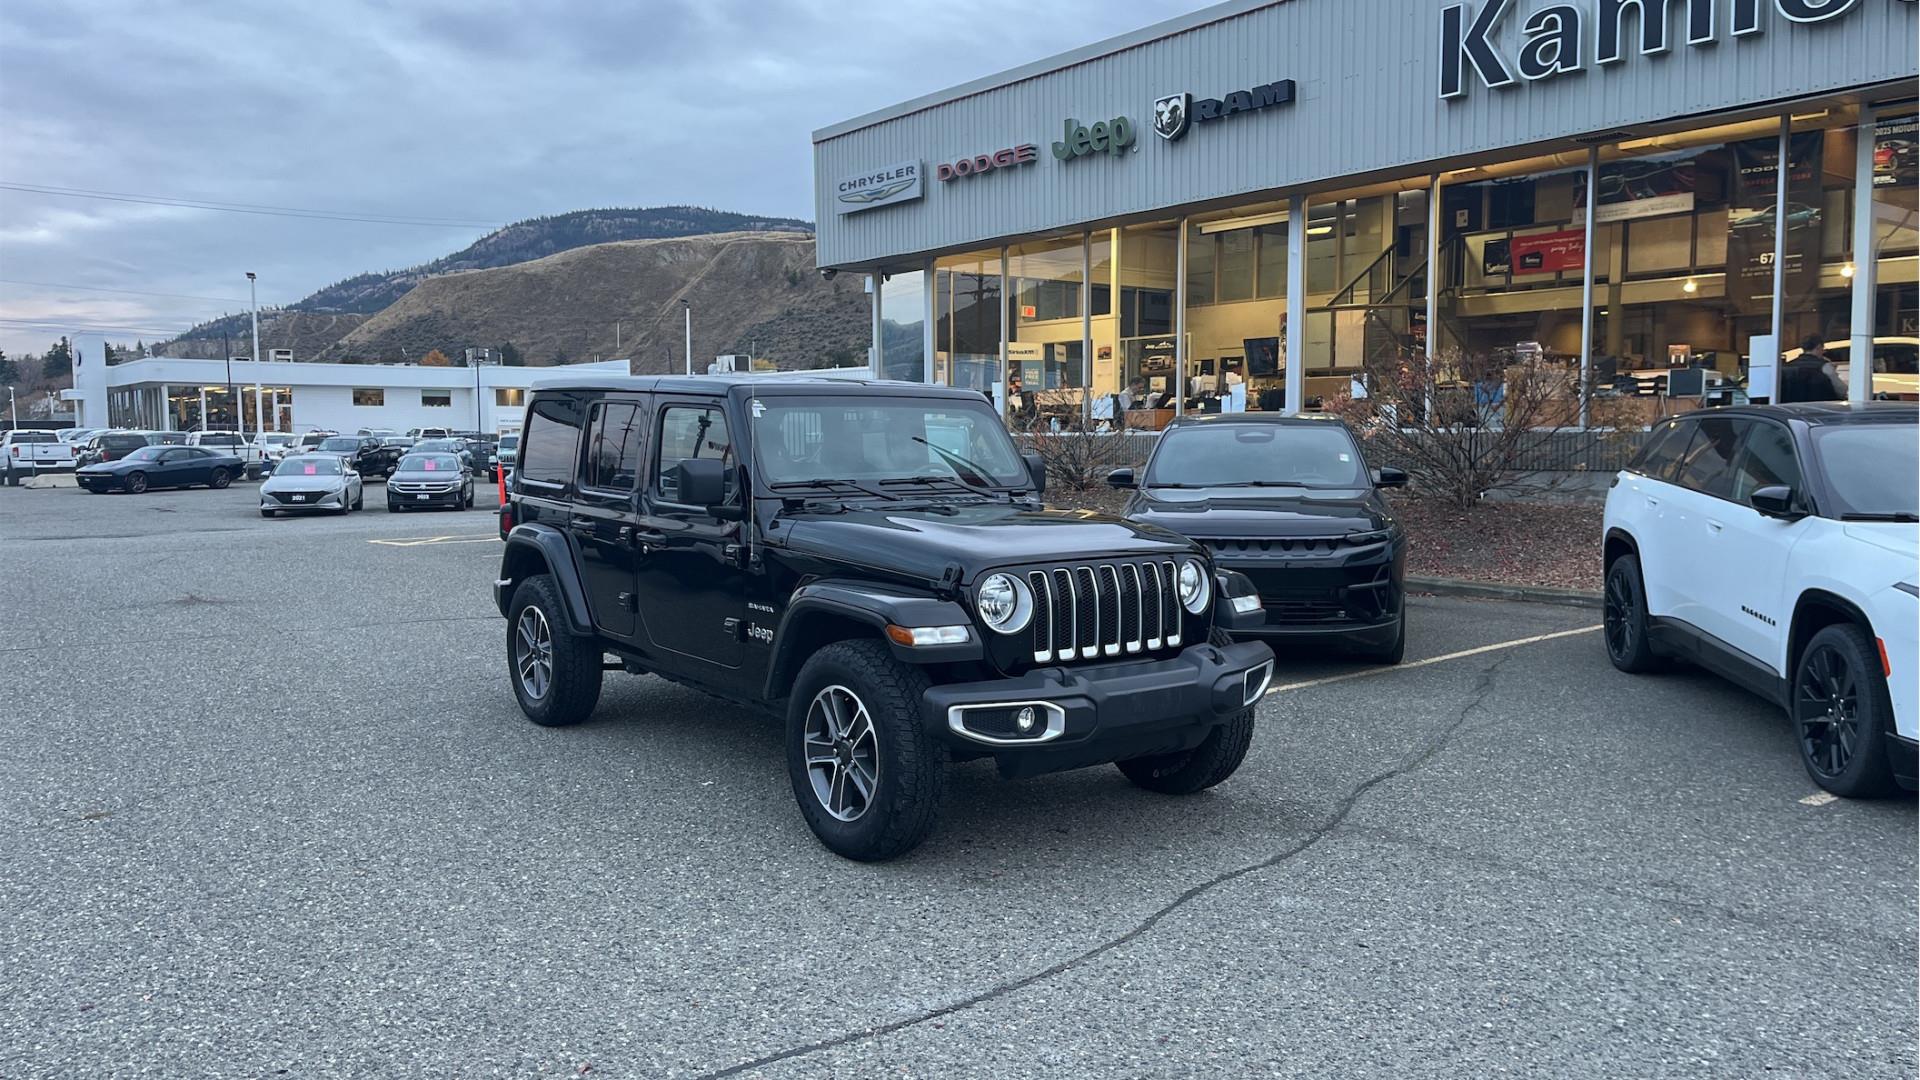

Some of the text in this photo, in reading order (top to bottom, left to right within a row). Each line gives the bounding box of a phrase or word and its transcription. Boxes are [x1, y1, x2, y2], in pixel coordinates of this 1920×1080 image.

[1438, 0, 1919, 99] Kam
[1192, 78, 1296, 122] RAM
[1051, 115, 1137, 161] Jeep
[839, 165, 915, 192] CHRYSLER
[937, 143, 1039, 182] DODGE
[1741, 162, 1796, 174] DODE
[1759, 253, 1776, 264] 67
[747, 622, 774, 644] Jeep
